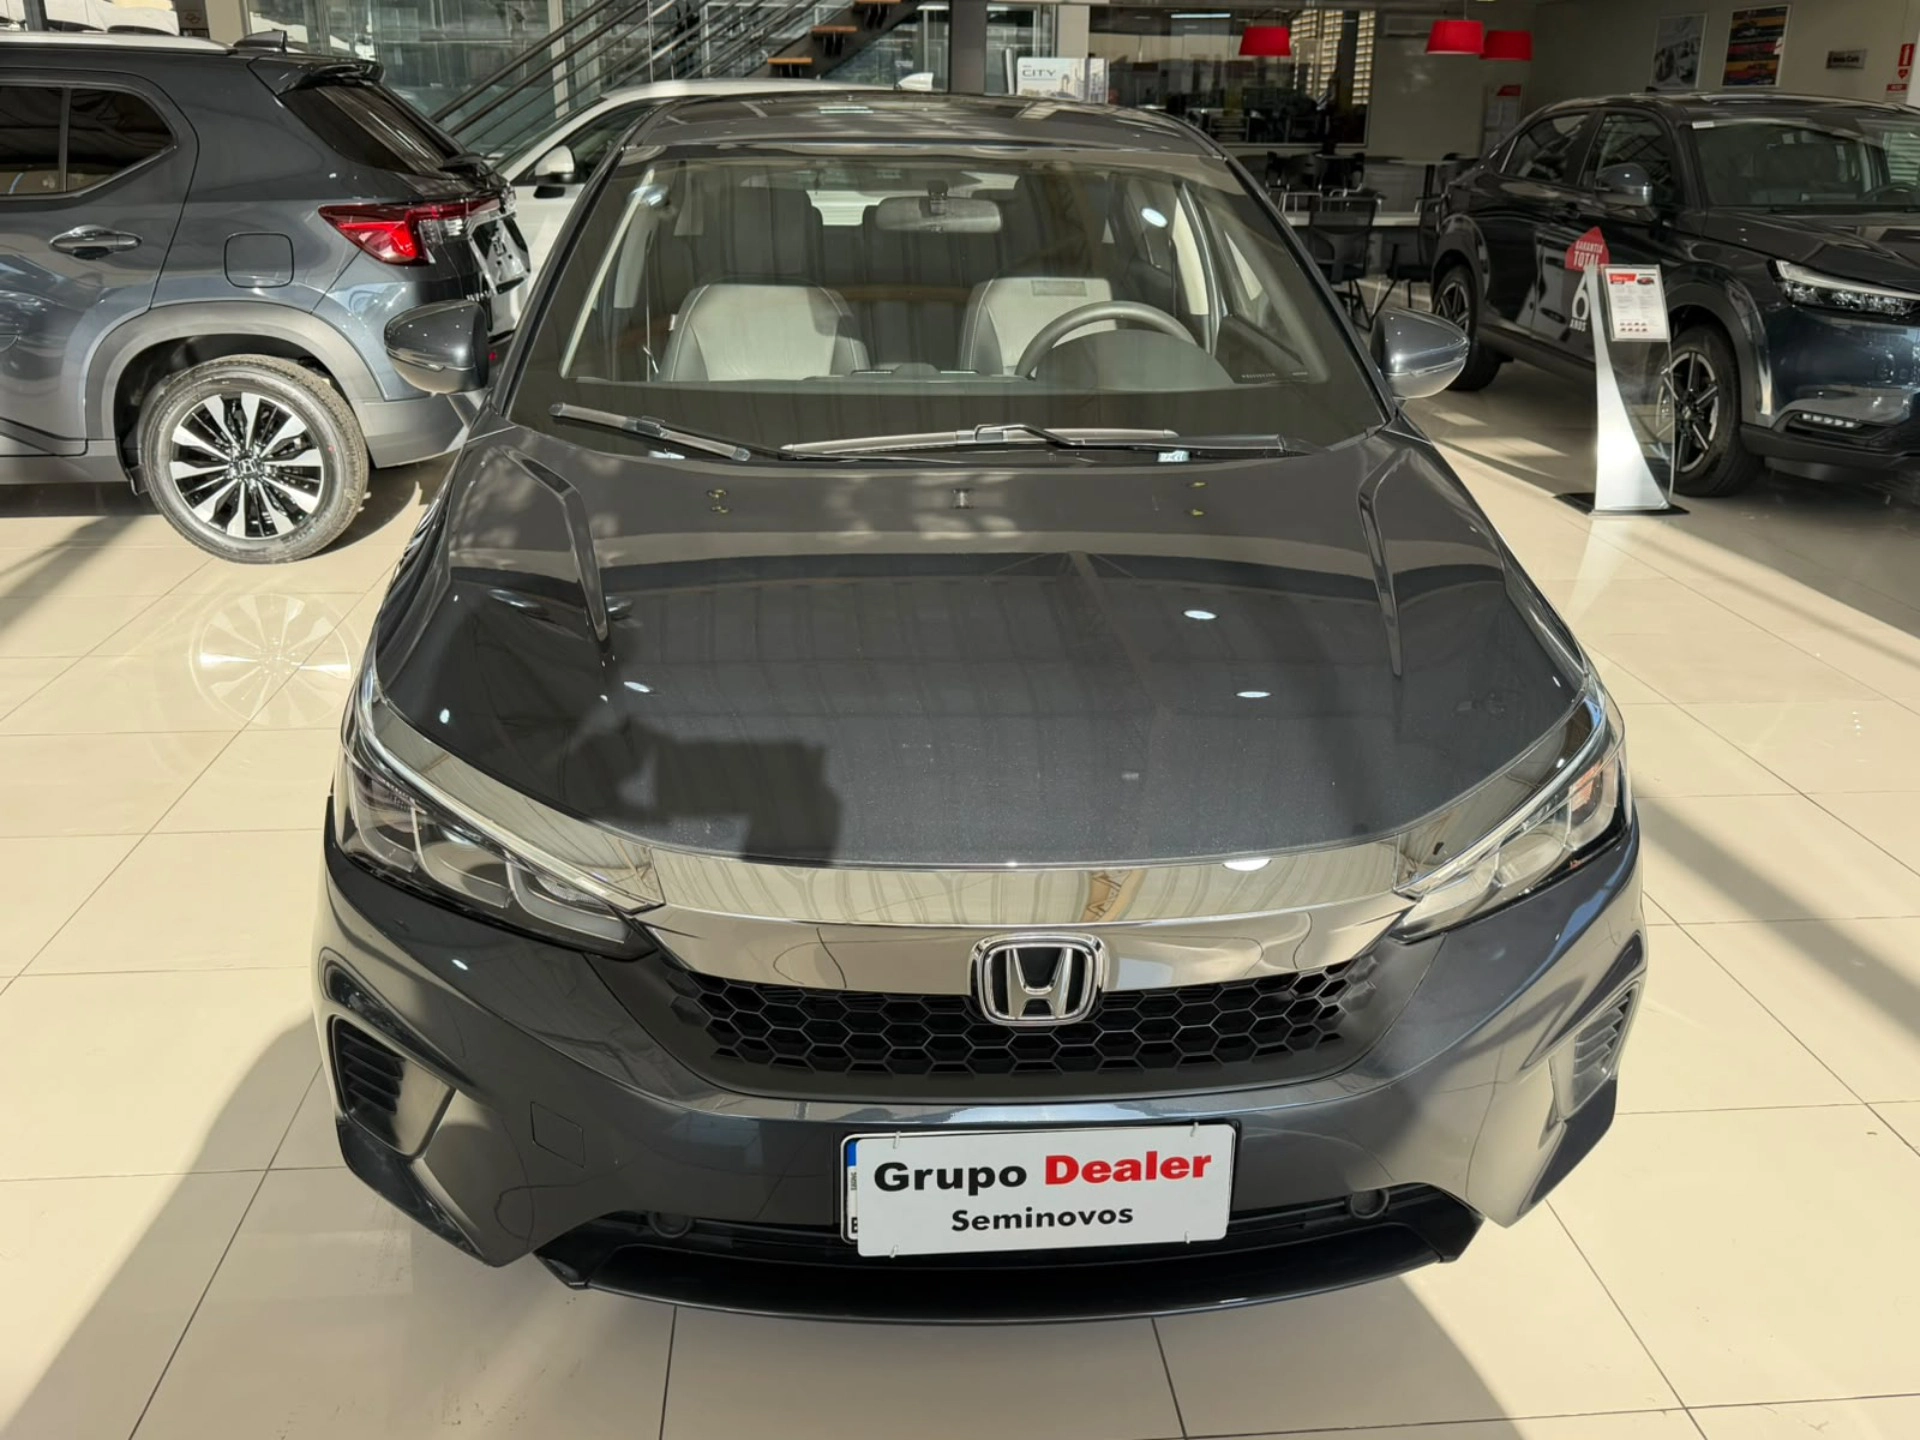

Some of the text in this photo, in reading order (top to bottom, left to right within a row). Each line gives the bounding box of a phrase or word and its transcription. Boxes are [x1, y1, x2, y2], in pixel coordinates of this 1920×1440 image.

[1022, 69, 1056, 77] CITY
[1574, 251, 1599, 266] TOTAL
[874, 1161, 1027, 1196] Grupo
[1045, 1151, 1211, 1185] Dealer
[952, 1206, 1133, 1231] Seminovos
